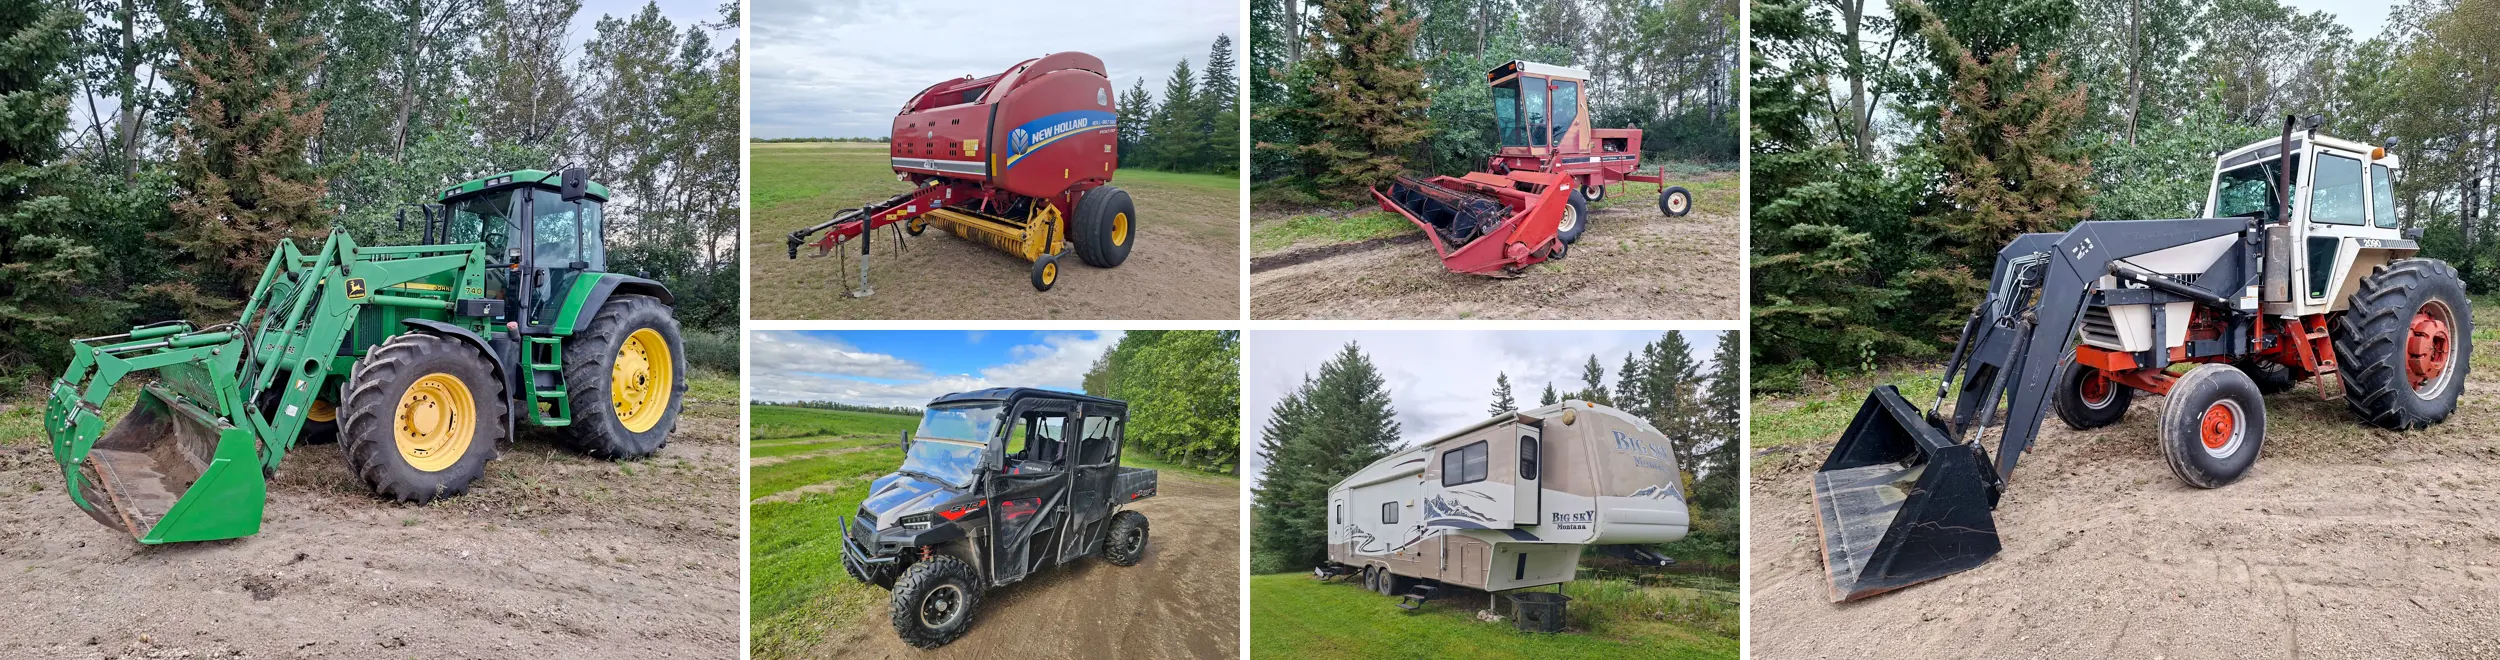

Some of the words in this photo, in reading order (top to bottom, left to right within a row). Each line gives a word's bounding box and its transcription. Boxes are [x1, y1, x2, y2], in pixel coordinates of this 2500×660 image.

[1032, 126, 1053, 144] NEW
[1053, 118, 1088, 136] HOLLAND
[2363, 239, 2382, 248] 2090
[464, 286, 482, 295] 740
[1611, 430, 1648, 454] BIG
[1552, 512, 1570, 522] BIG
[1573, 511, 1594, 521] SKY
